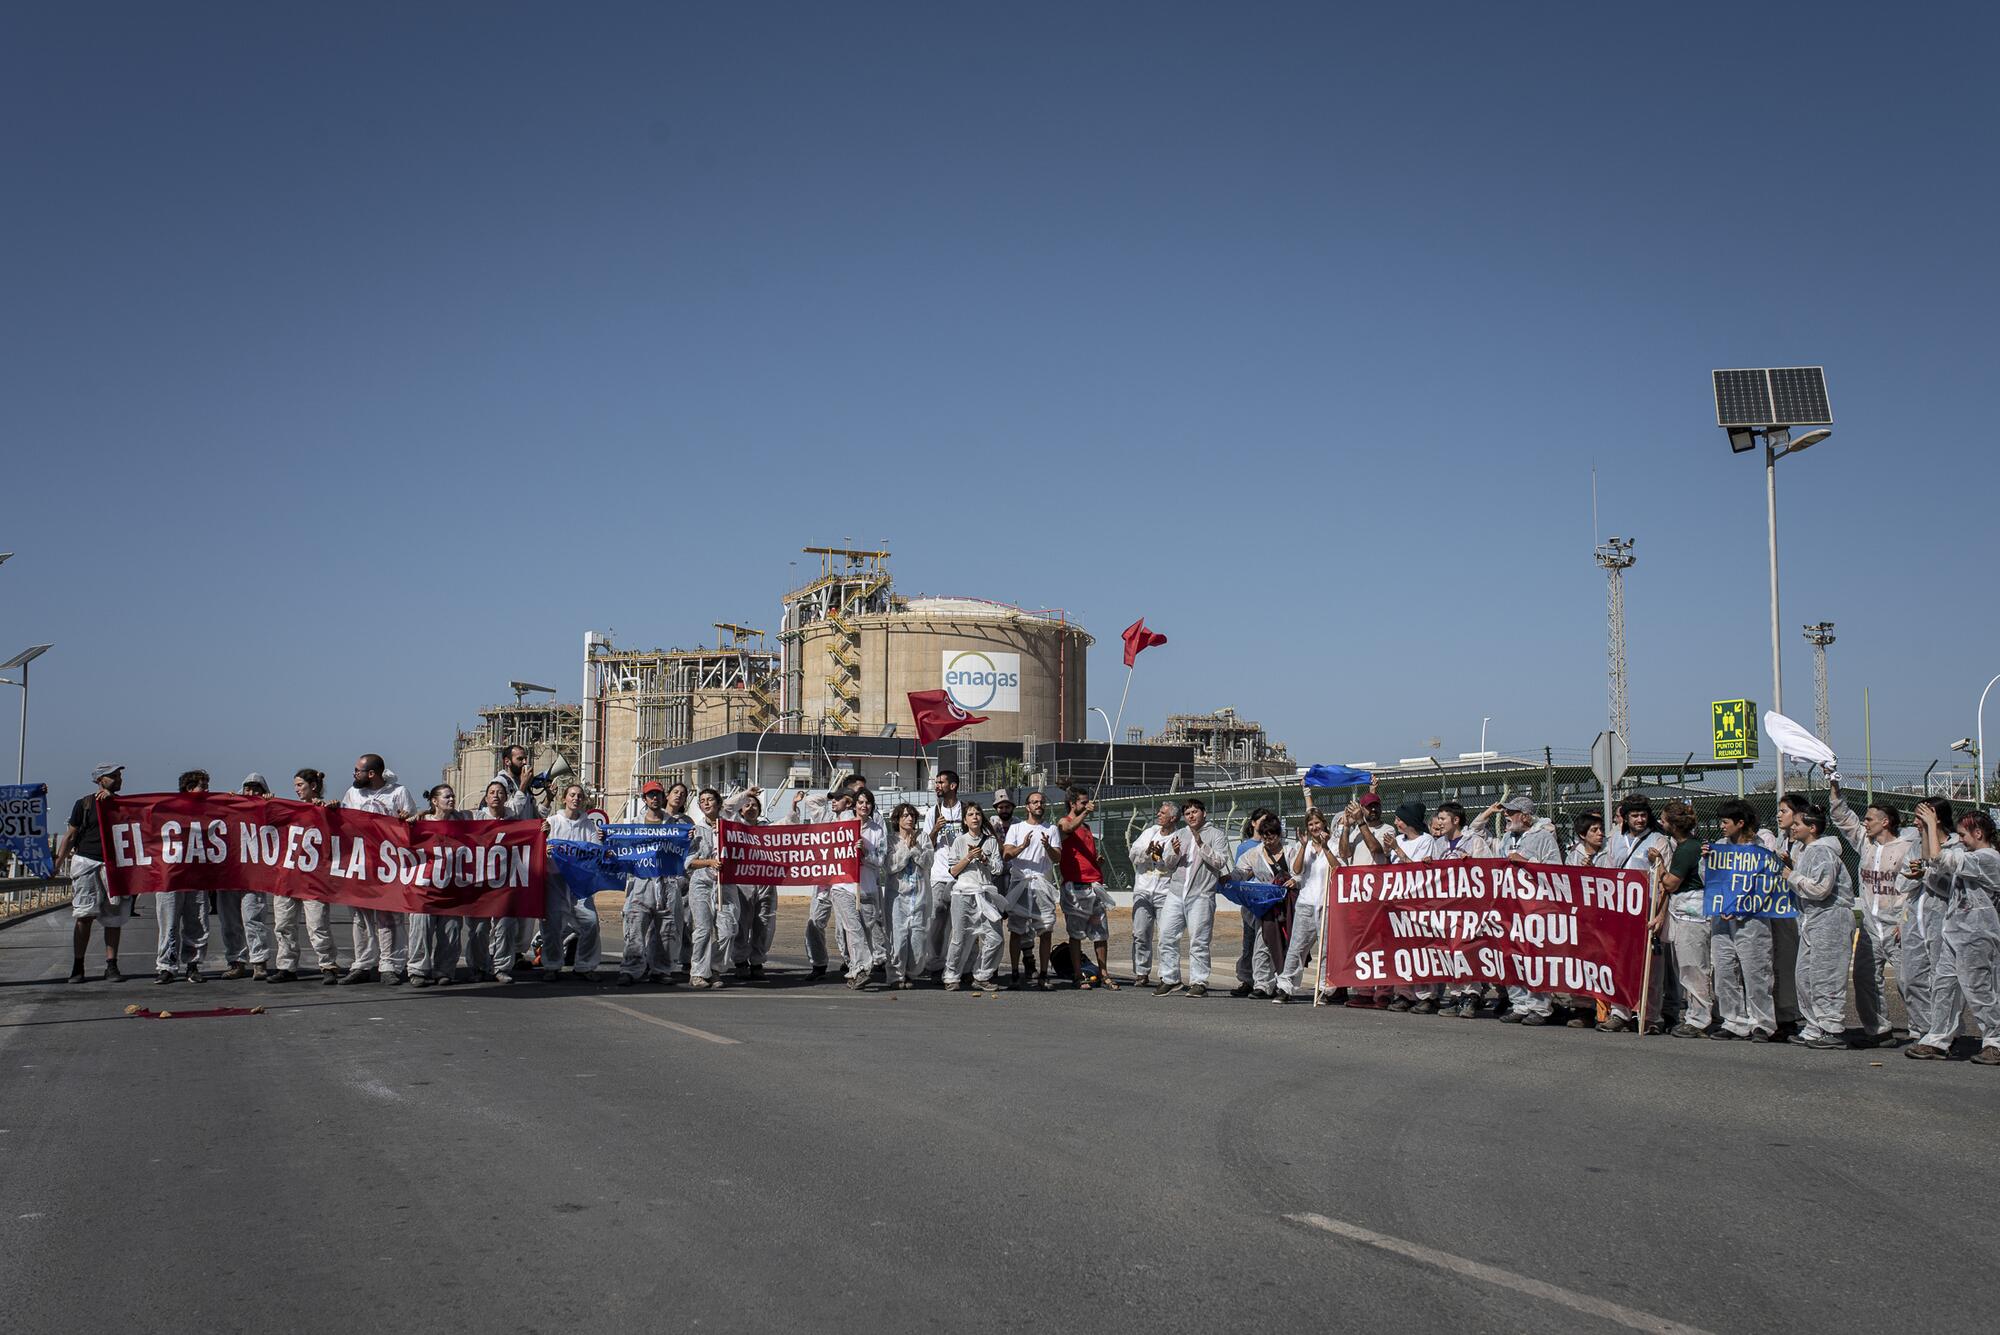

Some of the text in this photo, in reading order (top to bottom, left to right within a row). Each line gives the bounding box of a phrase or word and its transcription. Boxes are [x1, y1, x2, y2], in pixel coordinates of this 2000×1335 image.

[945, 669, 1018, 690] enagas
[634, 827, 680, 836] DESCANSAR
[726, 826, 854, 847] MENOS SUBVENCIÓN
[112, 822, 152, 868] EL
[160, 819, 228, 864] GAS
[240, 821, 280, 866] NO
[283, 825, 323, 873] ES
[329, 835, 367, 880] LA
[377, 832, 531, 889] SOLUCIÓN
[720, 846, 729, 859] A
[731, 846, 745, 860] LA
[748, 848, 816, 864] INDUSTRIA
[819, 847, 829, 861] Y
[1708, 849, 1761, 872] QUEMAN
[734, 863, 846, 878] JUSTICIA SOCIAL
[1337, 866, 1644, 916] LAS FAMILIAS PASAN FRÍO
[1712, 894, 1724, 913] A
[1735, 894, 1773, 913] TODO
[1388, 906, 1579, 949] MIENTRAS AQUÍ
[1355, 947, 1616, 996] SE QUEMA SU FUTURO
